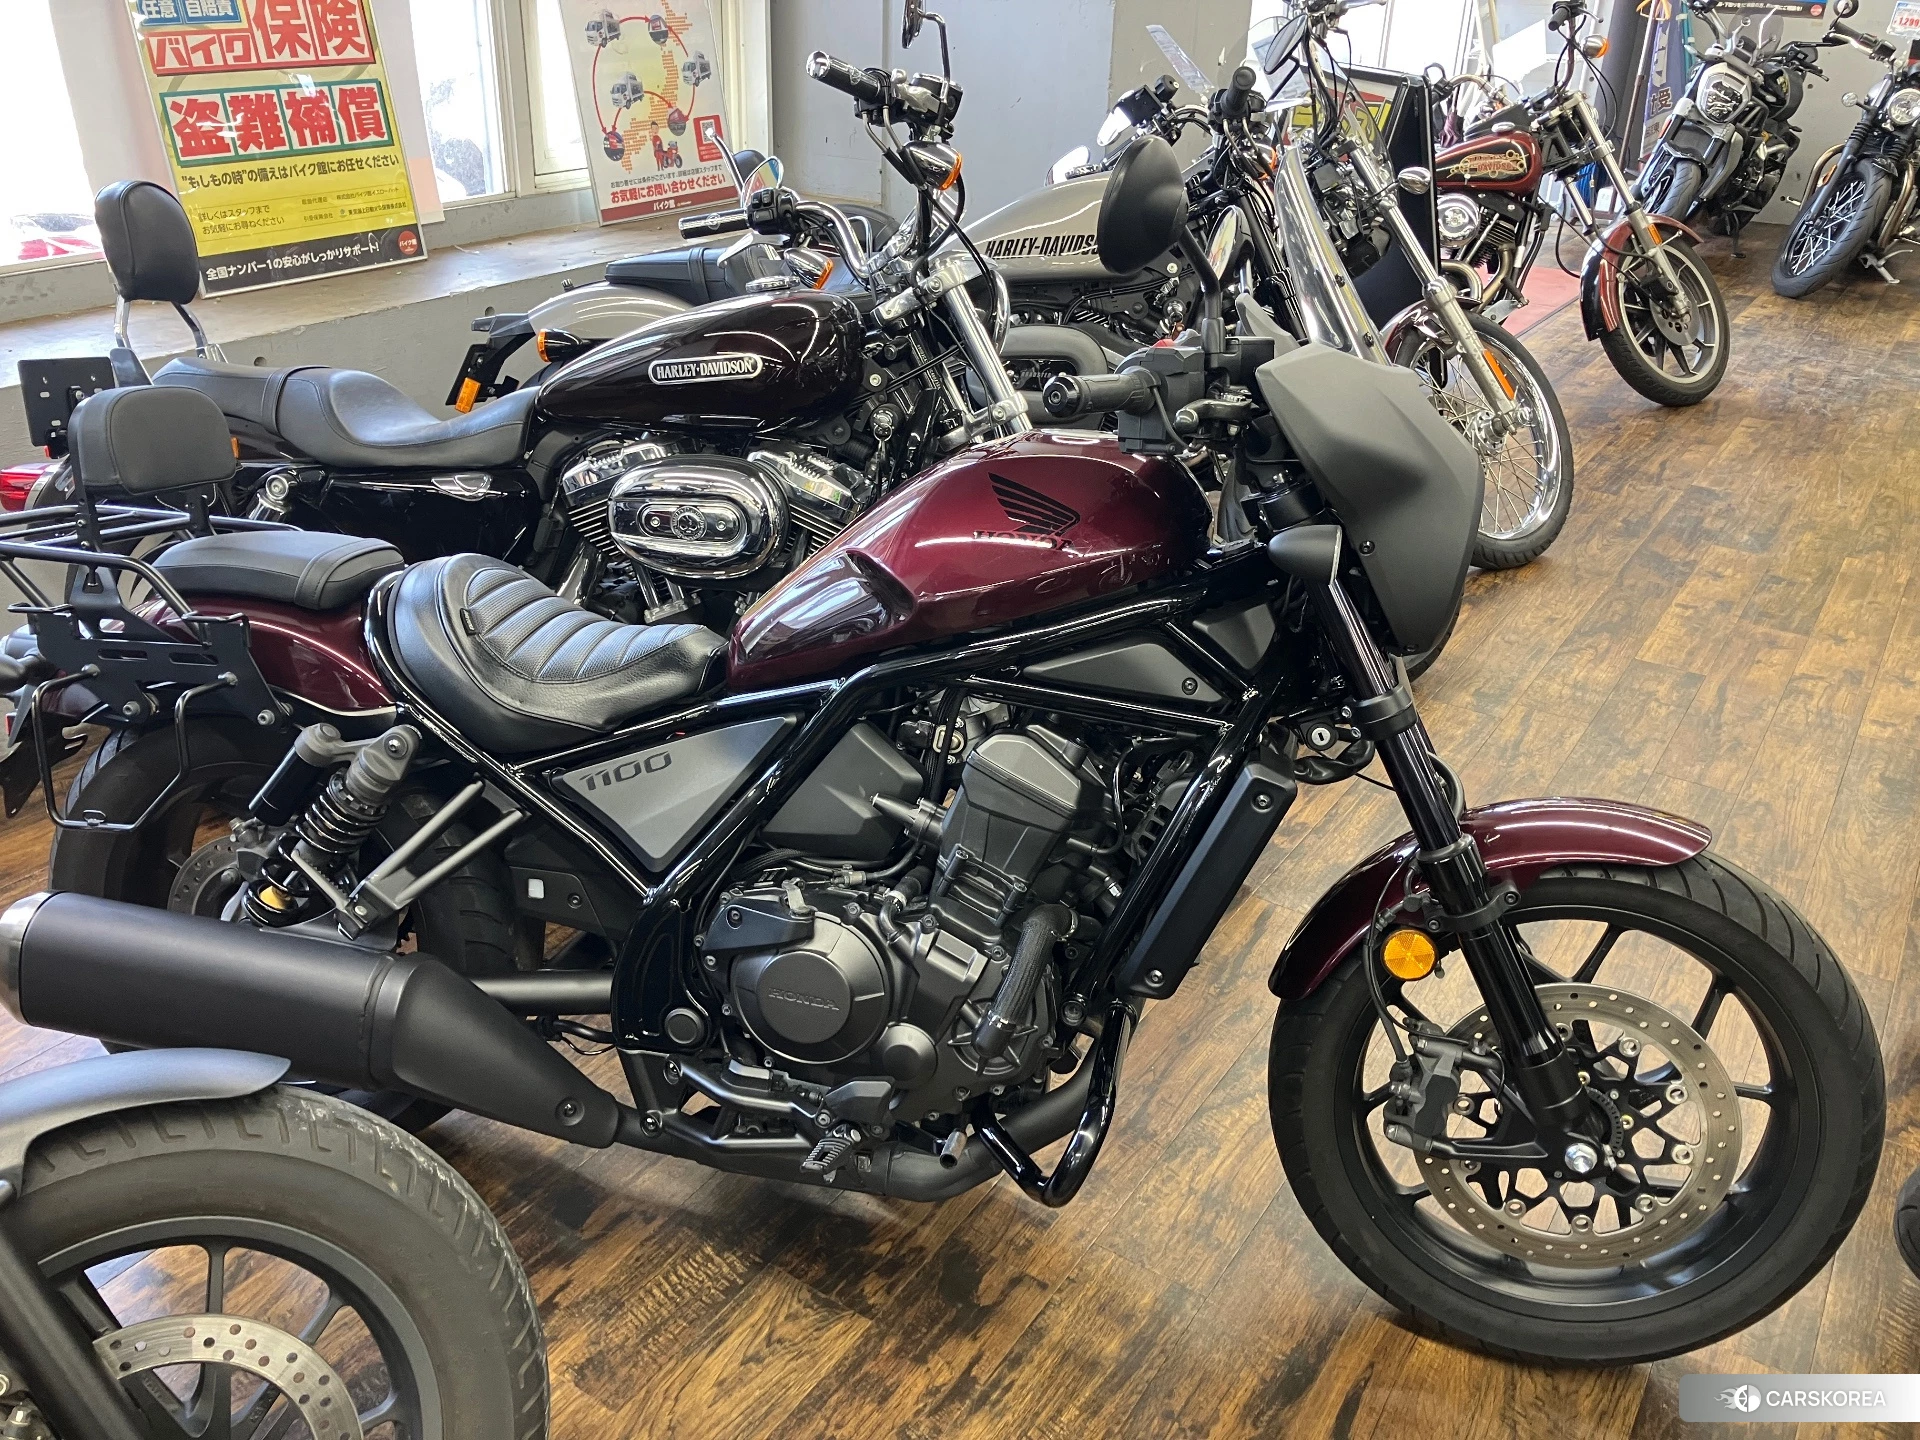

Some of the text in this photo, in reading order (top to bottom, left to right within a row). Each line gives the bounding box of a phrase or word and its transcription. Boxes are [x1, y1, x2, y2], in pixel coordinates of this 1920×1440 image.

[169, 86, 387, 158] 盗難補償
[611, 173, 726, 205] お気軽にお問い合わせください
[984, 234, 1099, 260] HARLEY-DAVIDS
[579, 750, 672, 792] 1100
[768, 986, 840, 1011] HONDA
